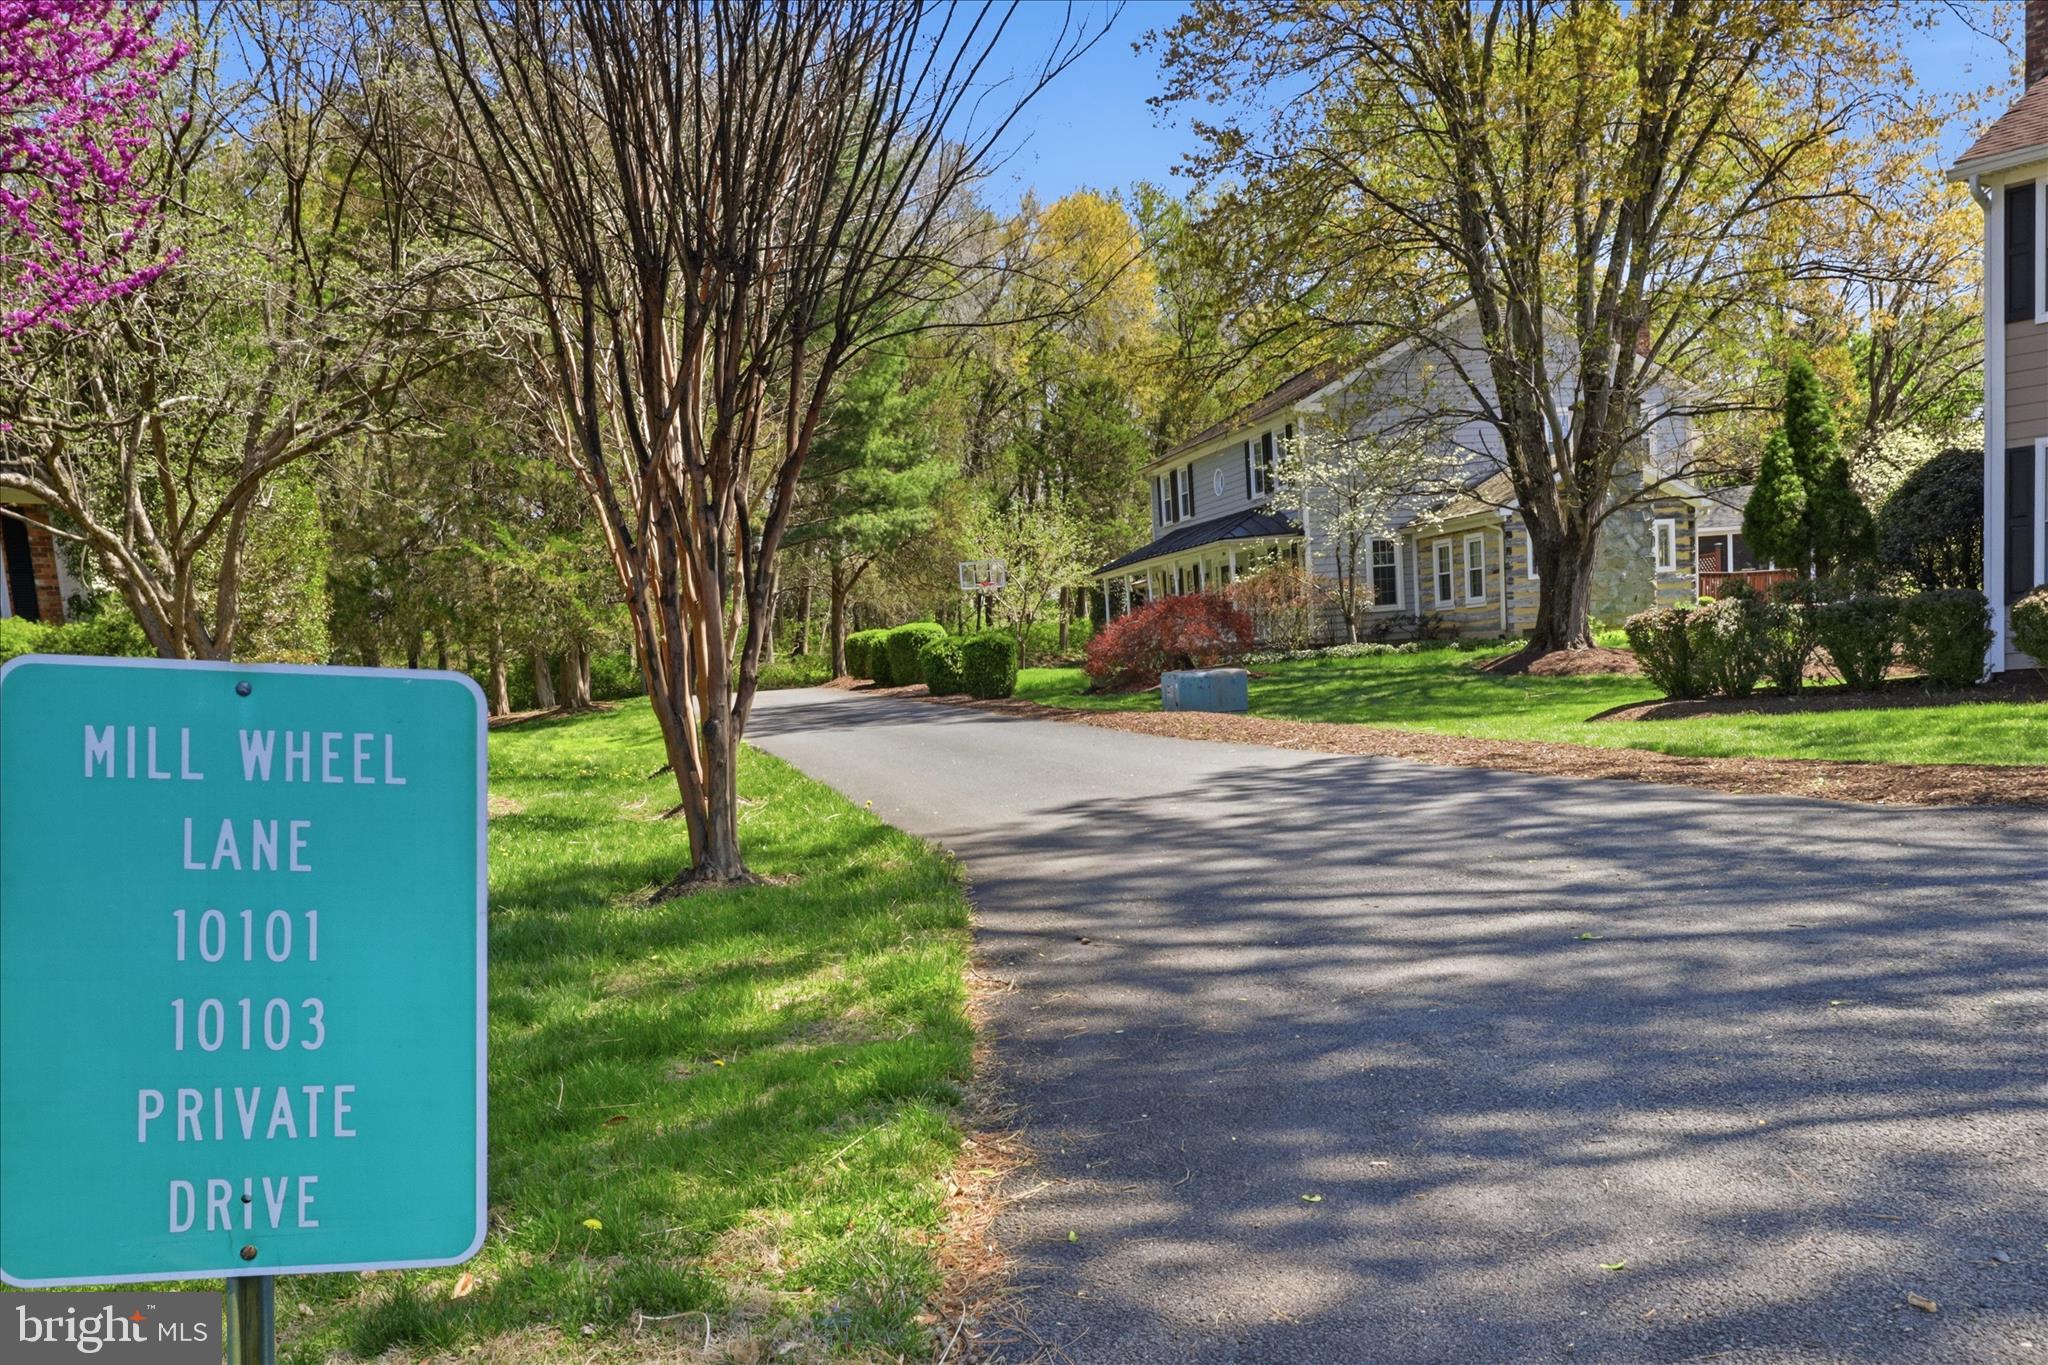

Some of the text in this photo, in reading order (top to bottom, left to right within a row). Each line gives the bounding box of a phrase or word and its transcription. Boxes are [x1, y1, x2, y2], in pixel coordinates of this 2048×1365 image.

[84, 725, 407, 785] MILL WHEEL
[184, 818, 312, 872] LANE
[174, 909, 318, 962] 10101
[172, 997, 326, 1052] 10103
[138, 1084, 356, 1142] PRIVATE
[170, 1176, 319, 1233] DRIVE
